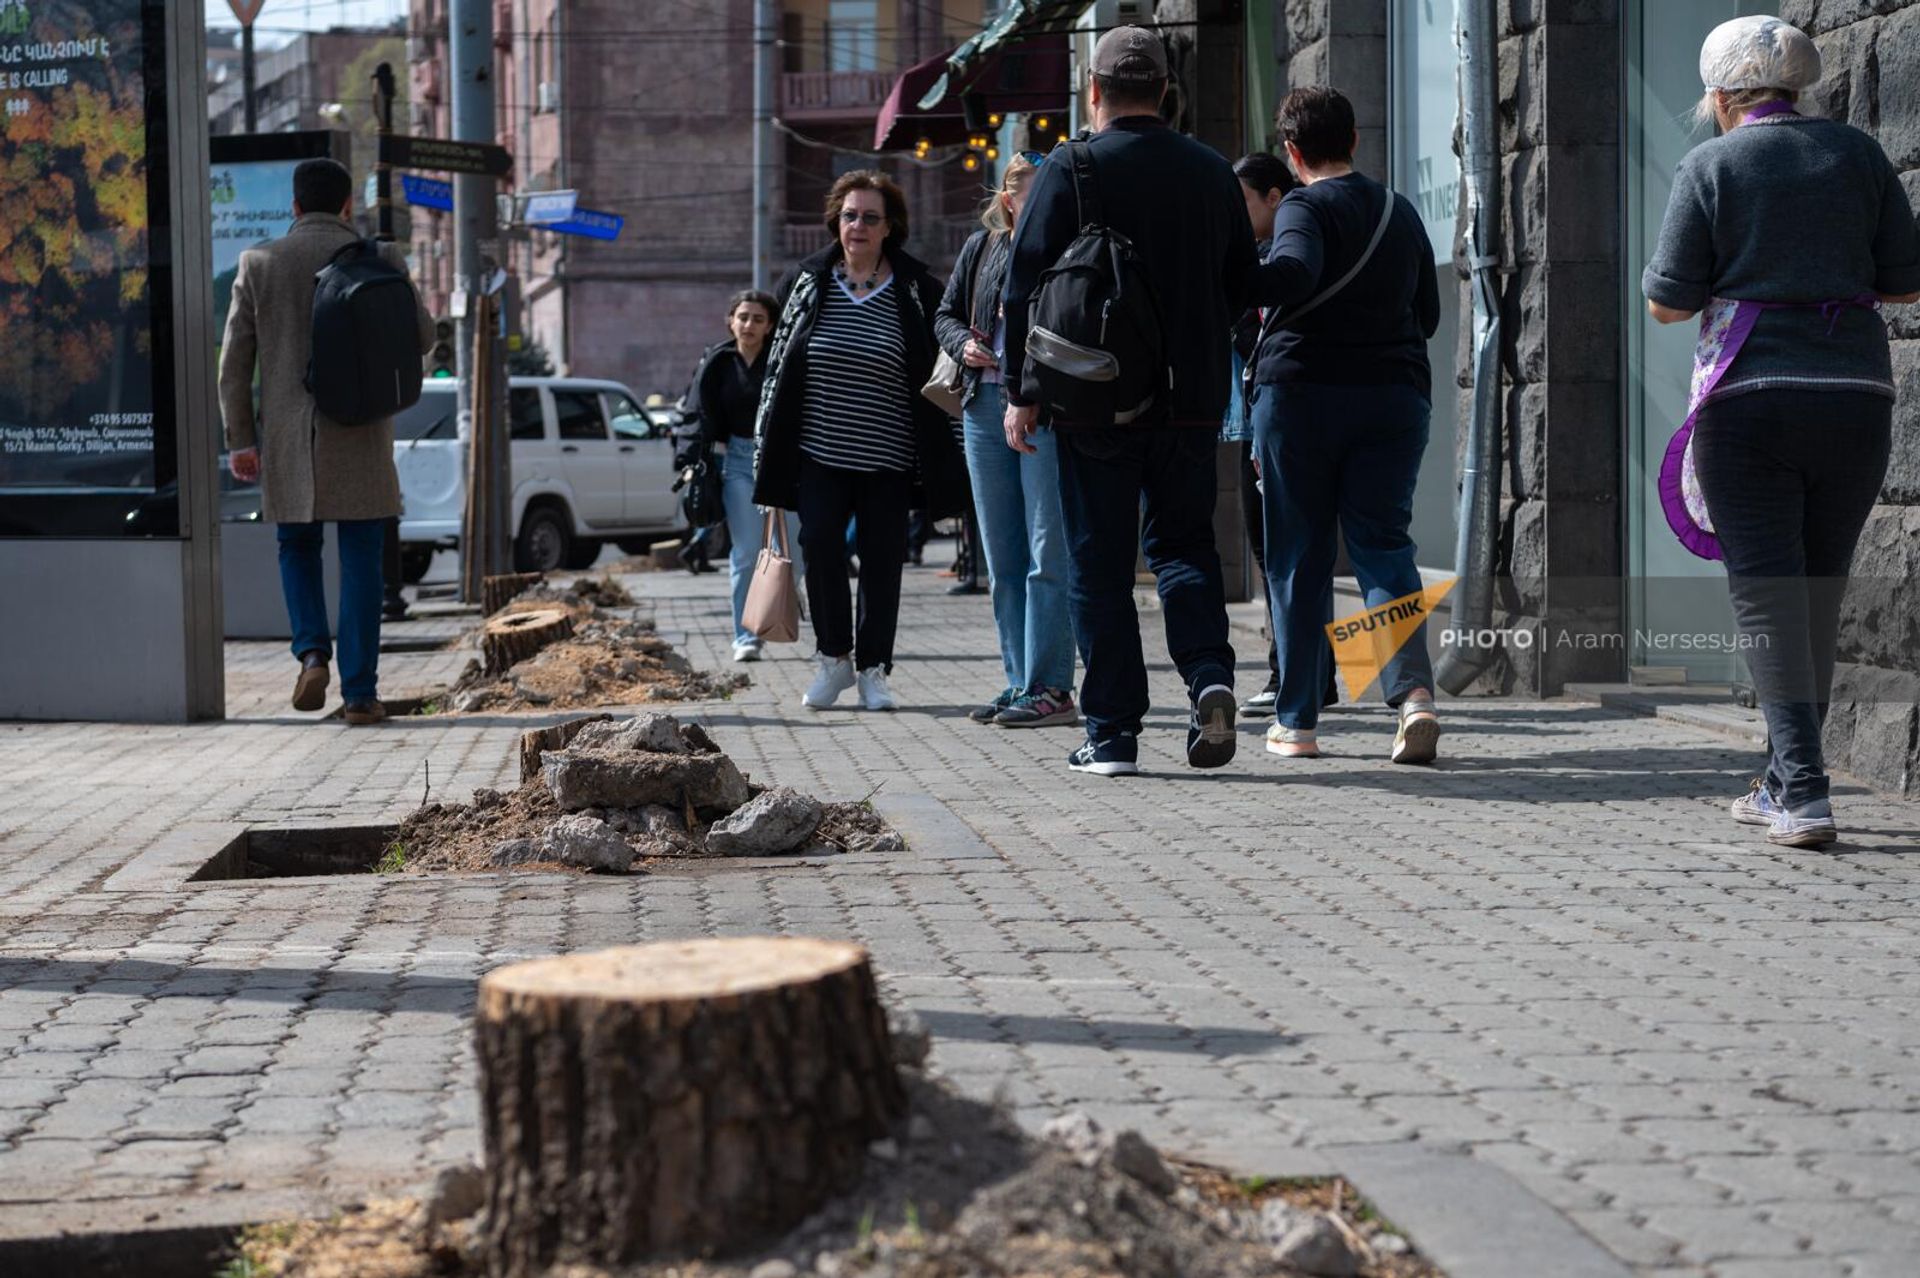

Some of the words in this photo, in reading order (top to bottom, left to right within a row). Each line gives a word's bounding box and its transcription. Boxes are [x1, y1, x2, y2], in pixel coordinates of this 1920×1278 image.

[9, 71, 21, 89] IS
[23, 68, 68, 87] CALLING
[25, 440, 55, 452] Maxim
[117, 439, 154, 451] Armenia
